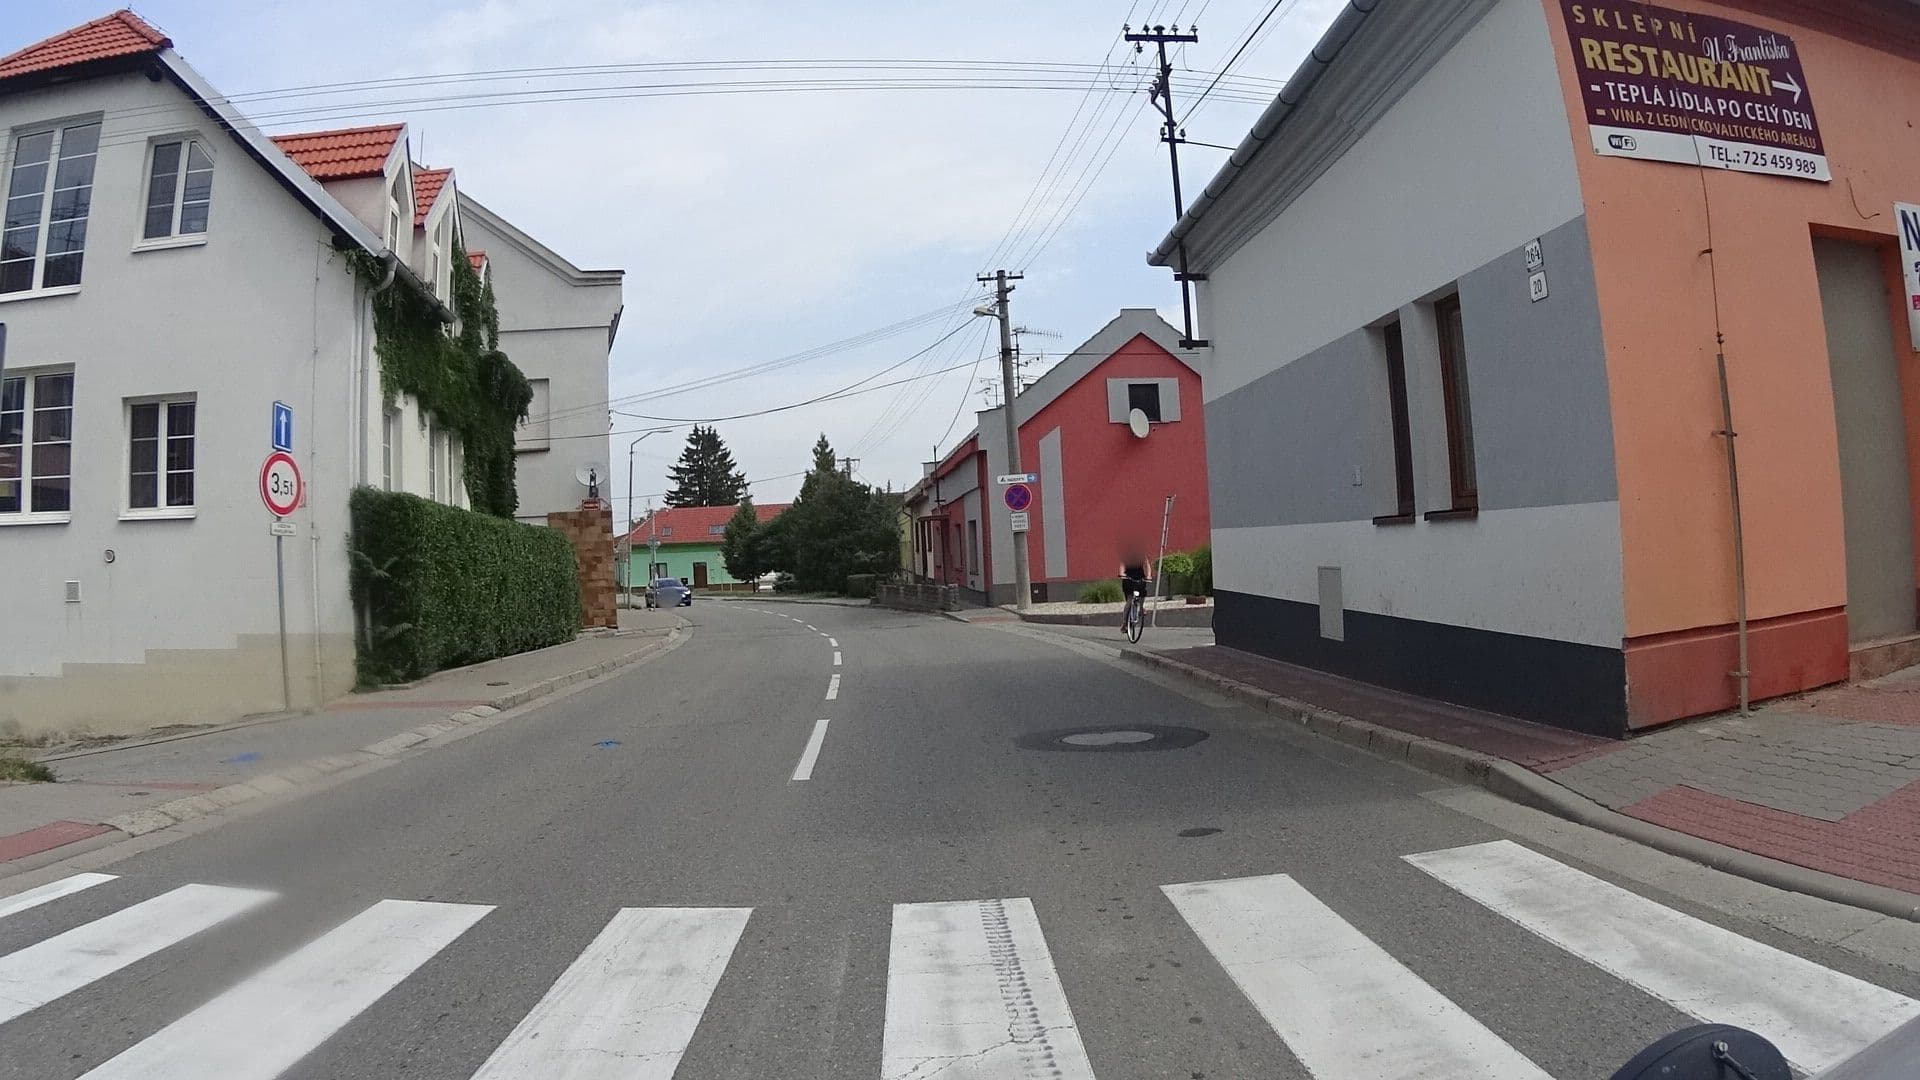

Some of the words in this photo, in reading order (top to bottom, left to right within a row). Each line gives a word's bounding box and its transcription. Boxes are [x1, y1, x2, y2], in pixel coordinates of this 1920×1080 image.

[1572, 4, 1696, 43] SKLEPNÍ
[1725, 34, 1790, 62] Františka
[1580, 37, 1772, 96] RESTAURANT
[1605, 82, 1665, 107] TEPLÁ
[1669, 88, 1716, 115] JÍDLA
[1717, 98, 1741, 118] PO
[1745, 102, 1779, 124] CELÝ
[1782, 109, 1812, 130] DEN
[1611, 107, 1644, 124] VÍNA
[1646, 112, 1654, 125] Z
[1781, 131, 1816, 149] AREÁLU
[1709, 145, 1740, 164] TEL.:
[1743, 150, 1767, 167] 725
[1770, 155, 1792, 170] 459
[1796, 158, 1816, 174] 989
[1526, 245, 1541, 264] 264
[271, 472, 293, 496] 3,5t
